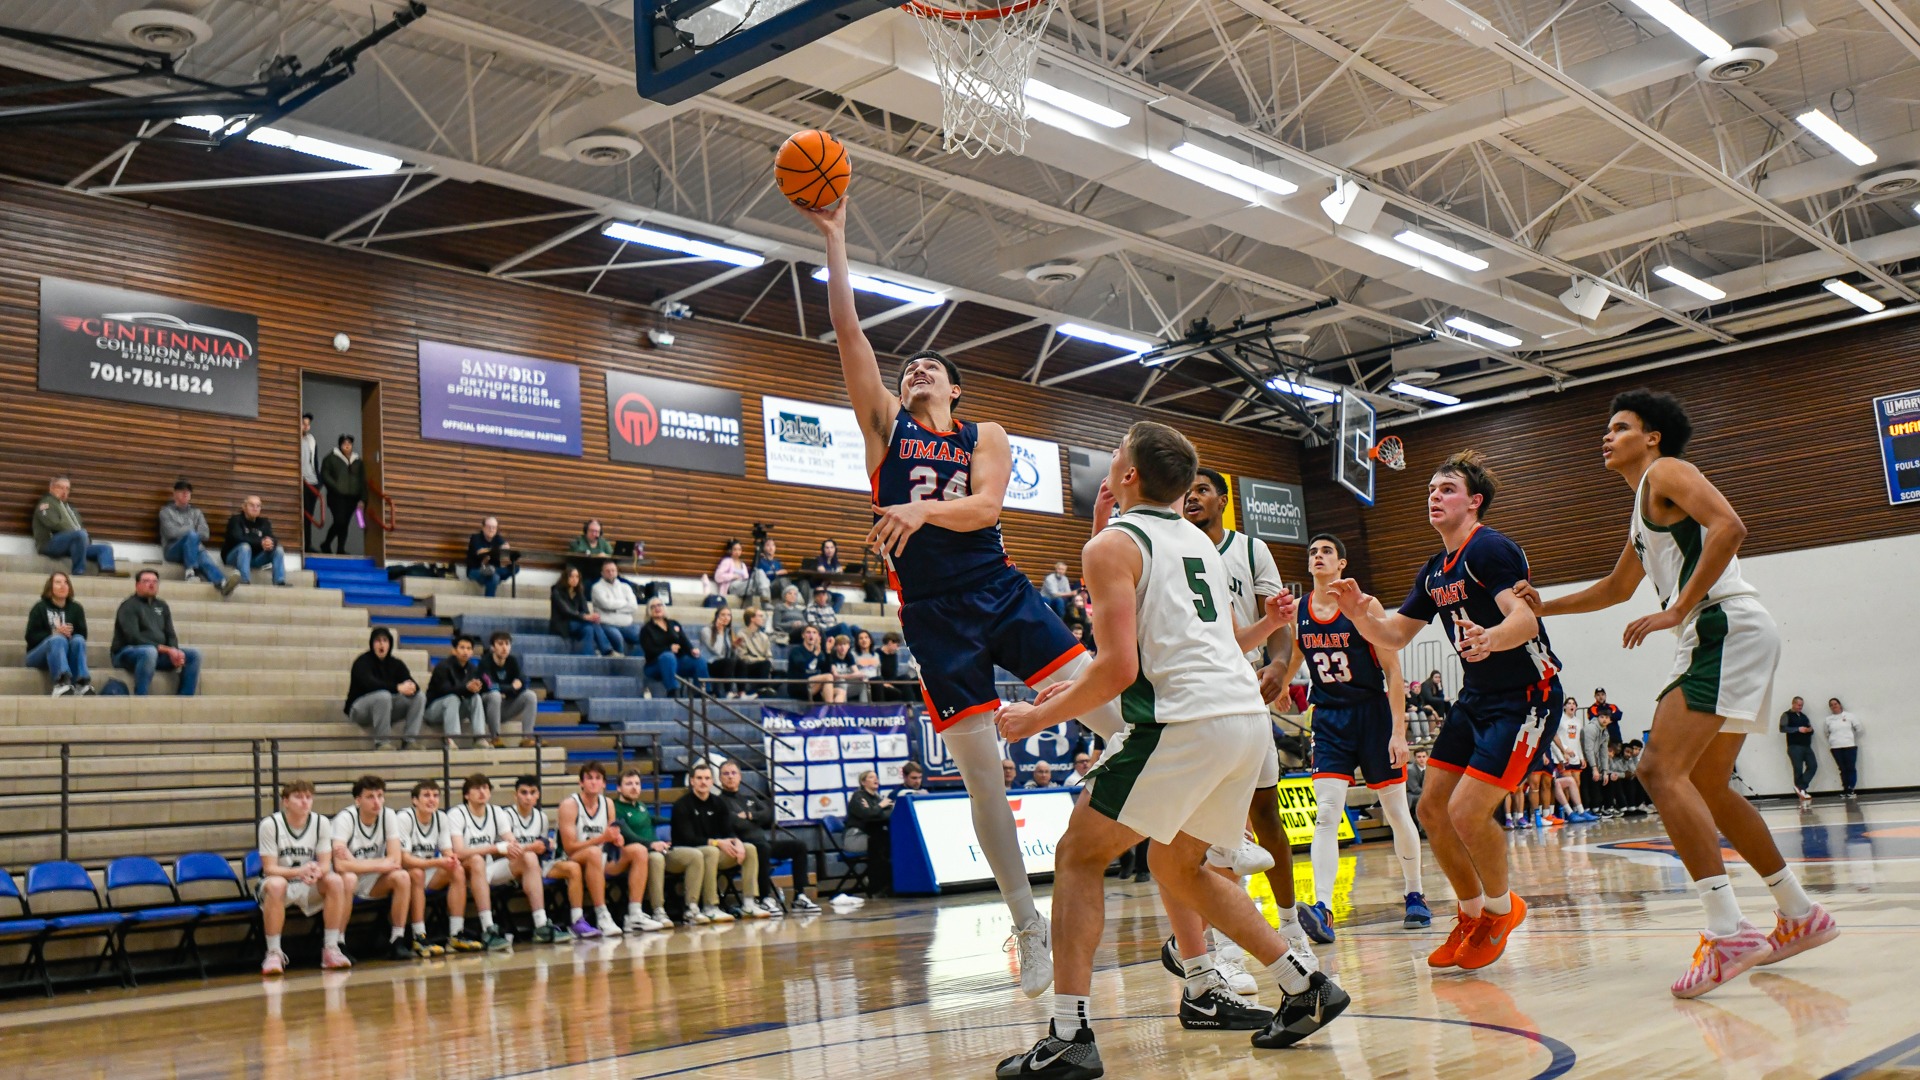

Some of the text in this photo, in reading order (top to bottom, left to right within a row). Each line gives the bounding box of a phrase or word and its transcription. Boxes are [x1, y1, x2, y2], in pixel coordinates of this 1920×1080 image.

[82, 317, 249, 360] CENTENNIAL
[96, 336, 243, 369] COLLISION & PAINT
[89, 361, 214, 395] 701-751-1524
[461, 358, 546, 386] SANFORD
[447, 383, 561, 409] SPORTS MEDICINE
[459, 376, 549, 398] ORTHOPEDICS
[442, 419, 567, 444] OFFICIAL SPORTS MEDICINE PARTNER
[660, 408, 739, 434] mann
[770, 414, 834, 447] Dakota
[661, 425, 740, 446] SIGNS, INC
[770, 451, 797, 464] BANK
[808, 457, 836, 469] TRUST
[899, 438, 971, 467] UMAR
[909, 465, 970, 501] 24
[1900, 489, 1920, 501] SCOR
[1246, 496, 1301, 519] Hometown
[1249, 513, 1300, 527] ORTHODONTICS
[1182, 556, 1219, 623] 5
[1301, 632, 1351, 649] UMARY
[1312, 650, 1352, 684] 23
[857, 715, 906, 728] PARTNERS
